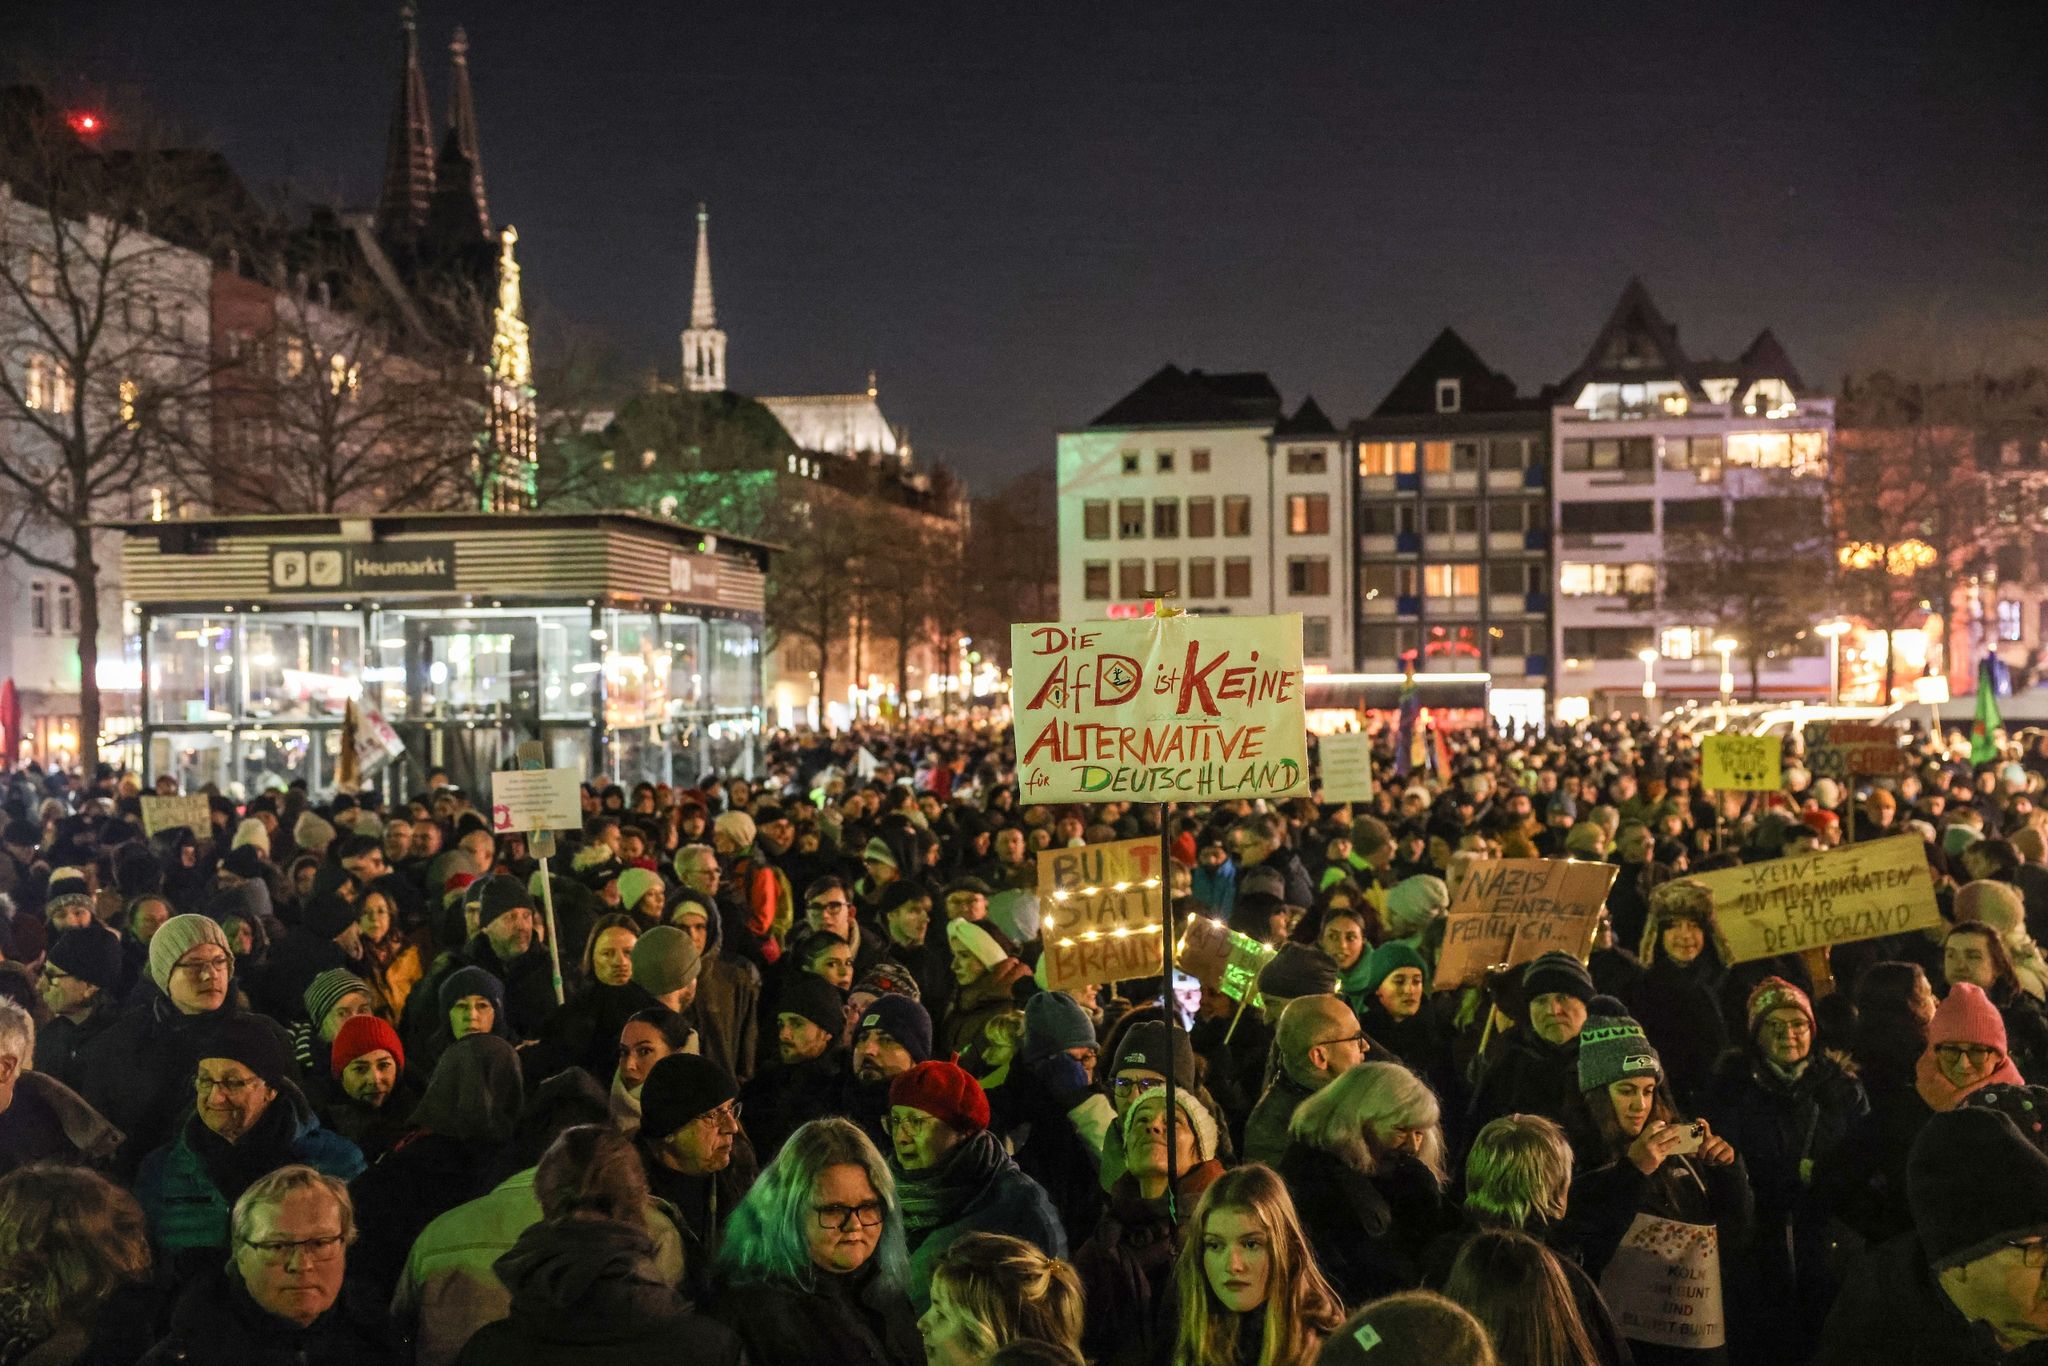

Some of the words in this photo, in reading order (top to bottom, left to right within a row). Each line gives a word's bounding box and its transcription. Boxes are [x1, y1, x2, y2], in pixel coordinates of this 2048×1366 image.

[354, 556, 446, 577] Heumarkt
[1026, 655, 1144, 714] AfD
[1153, 664, 1181, 695] ist
[1071, 757, 1299, 796] DEUTSCHLAND
[1053, 845, 1158, 887] BUNT
[1463, 868, 1549, 902] NAZIS
[1055, 936, 1161, 983] BRAUN
